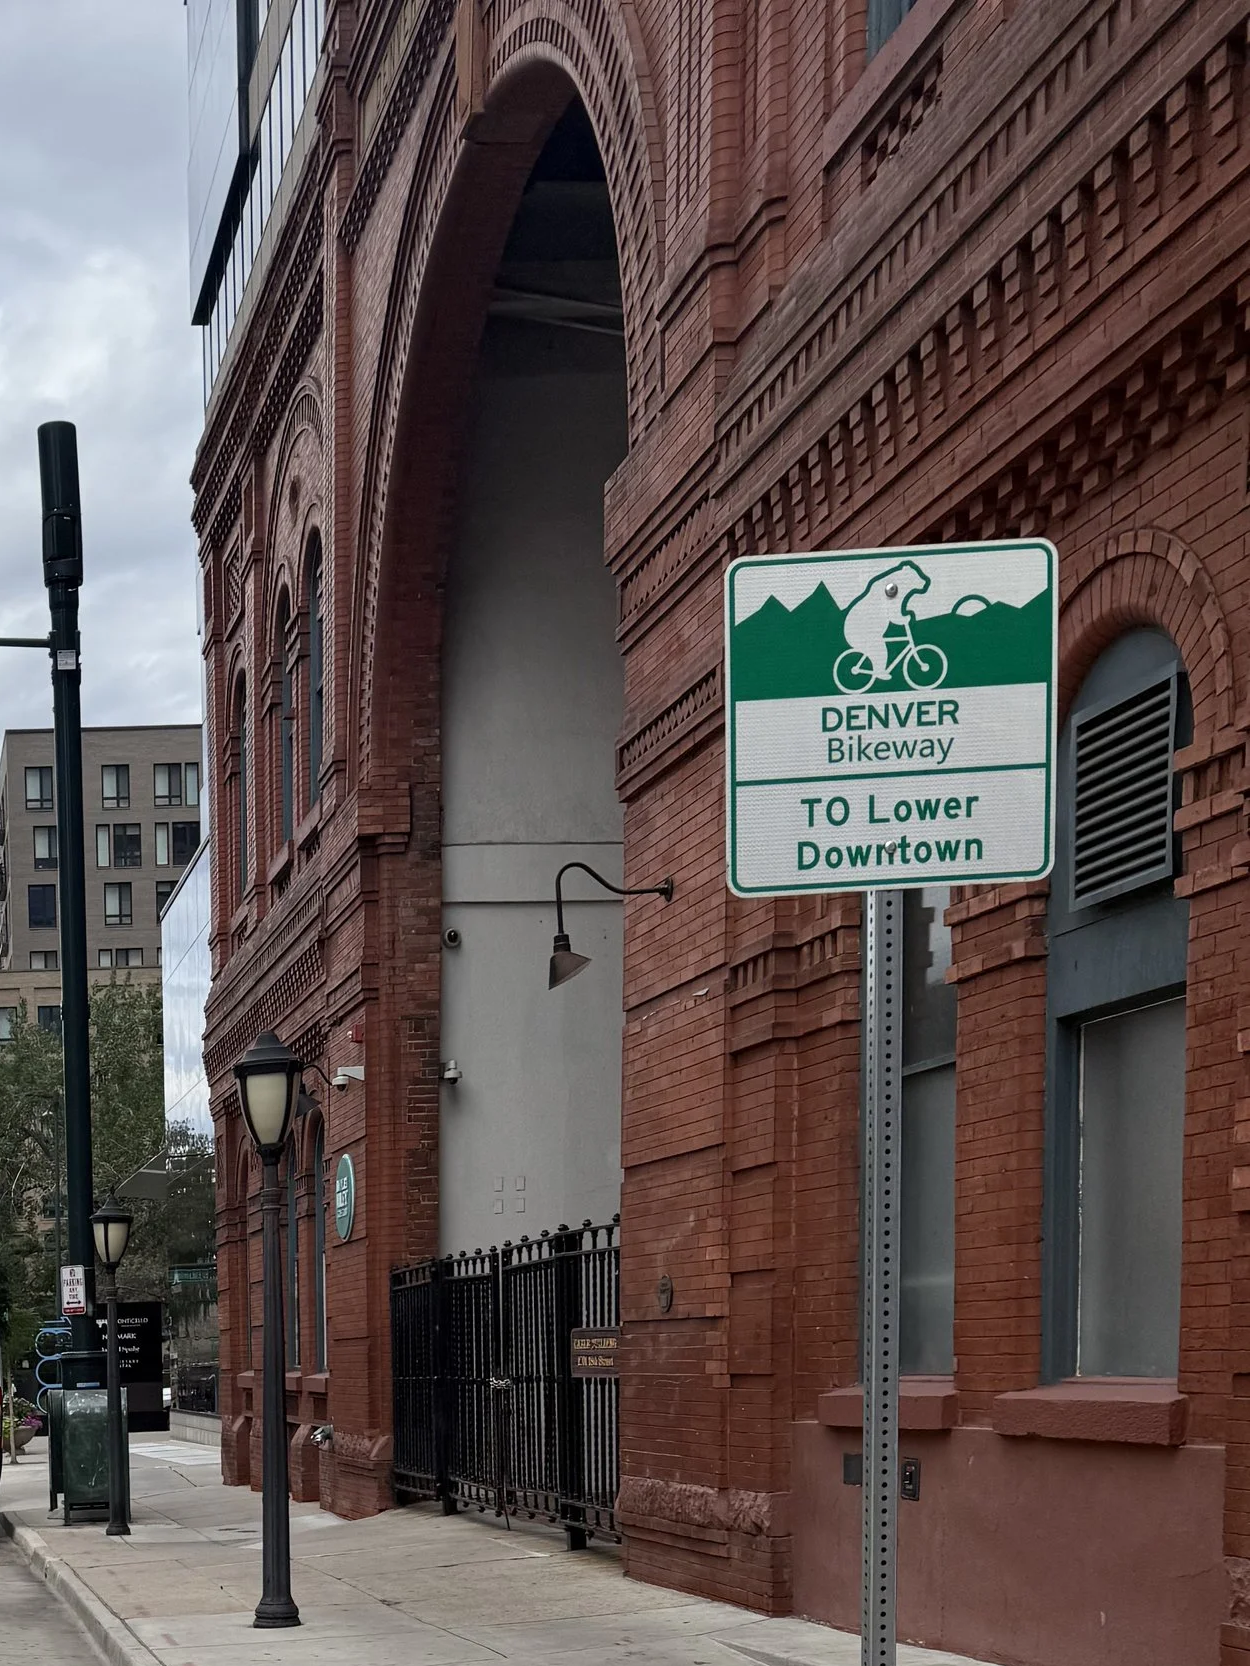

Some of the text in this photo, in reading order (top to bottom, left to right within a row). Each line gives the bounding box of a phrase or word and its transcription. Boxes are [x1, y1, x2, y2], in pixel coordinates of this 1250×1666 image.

[822, 699, 959, 732] DENVER
[828, 735, 954, 764] Bikeway
[801, 795, 979, 828] TO Lower
[798, 835, 983, 871] Downtown
[117, 1317, 149, 1325] ONTICELLO
